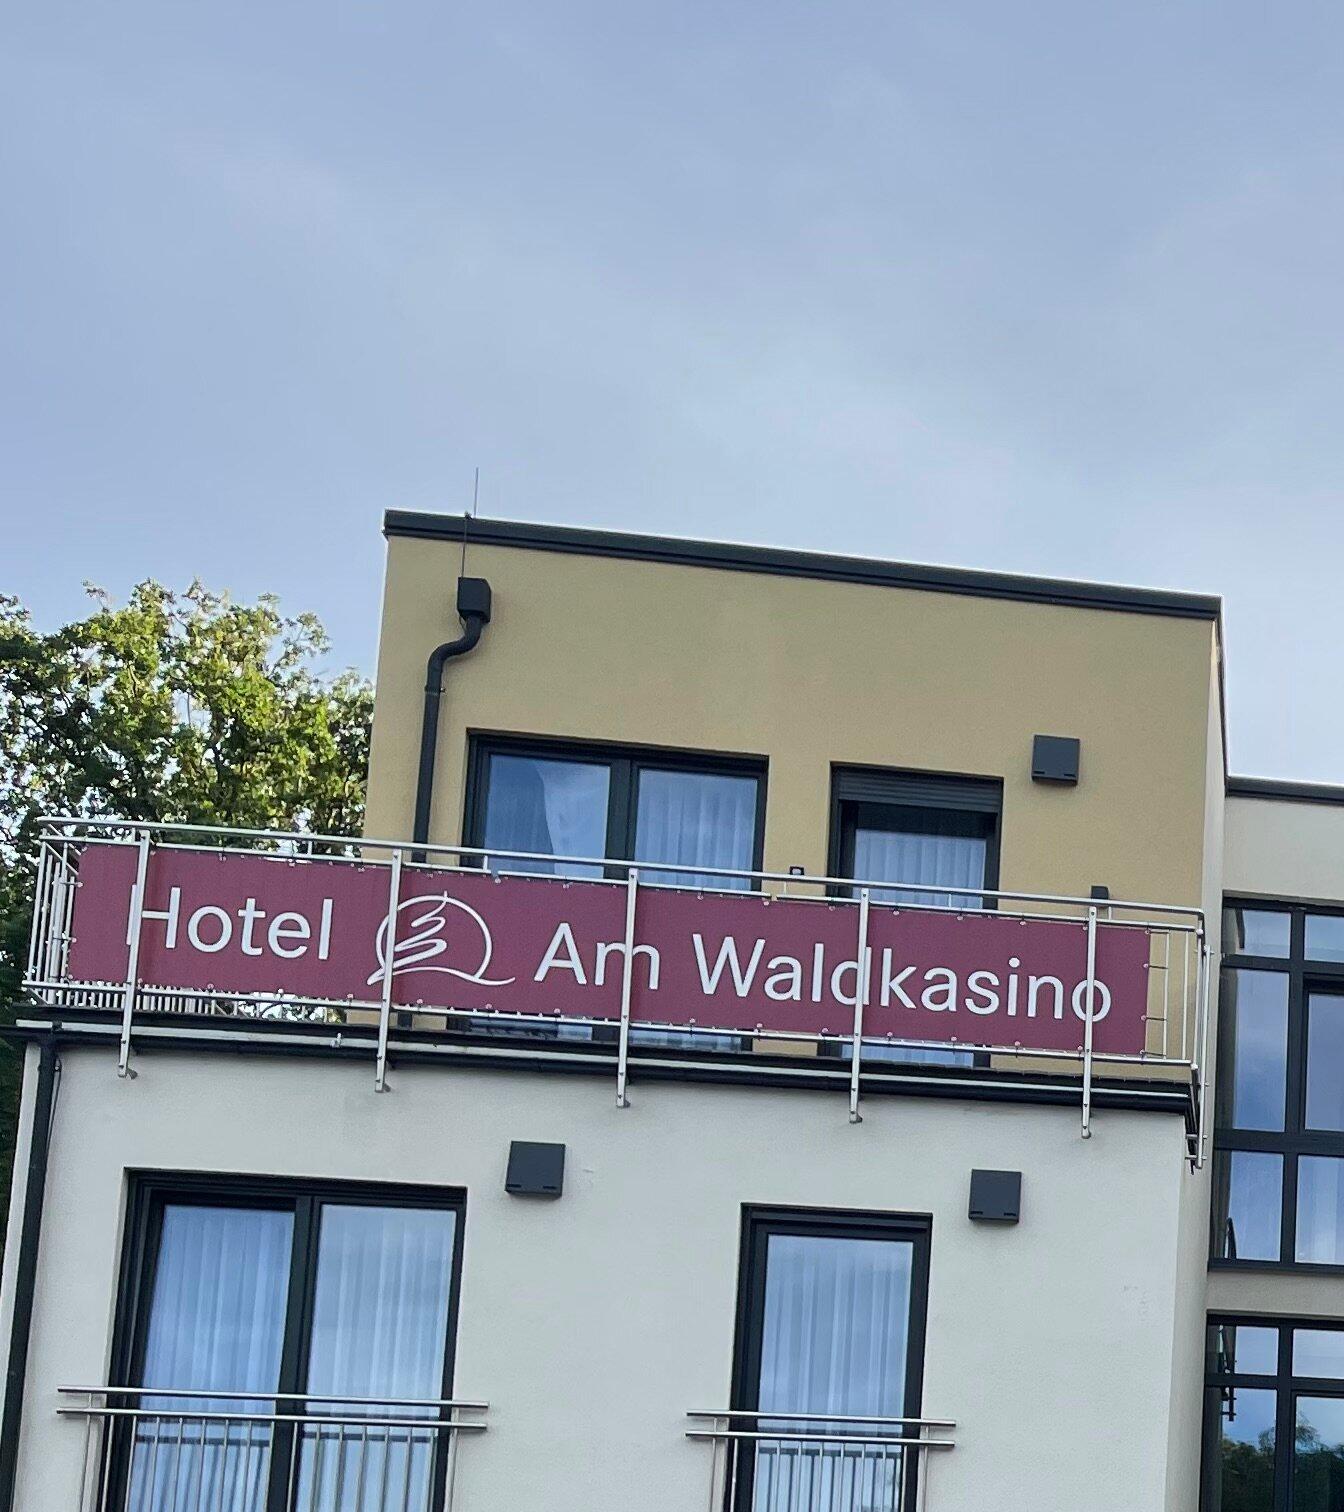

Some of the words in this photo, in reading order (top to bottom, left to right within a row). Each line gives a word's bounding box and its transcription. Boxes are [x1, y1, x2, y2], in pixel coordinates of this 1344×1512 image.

[126, 884, 333, 960] Hotel
[534, 922, 660, 990] Am
[692, 934, 1111, 1022] Waldkasino
